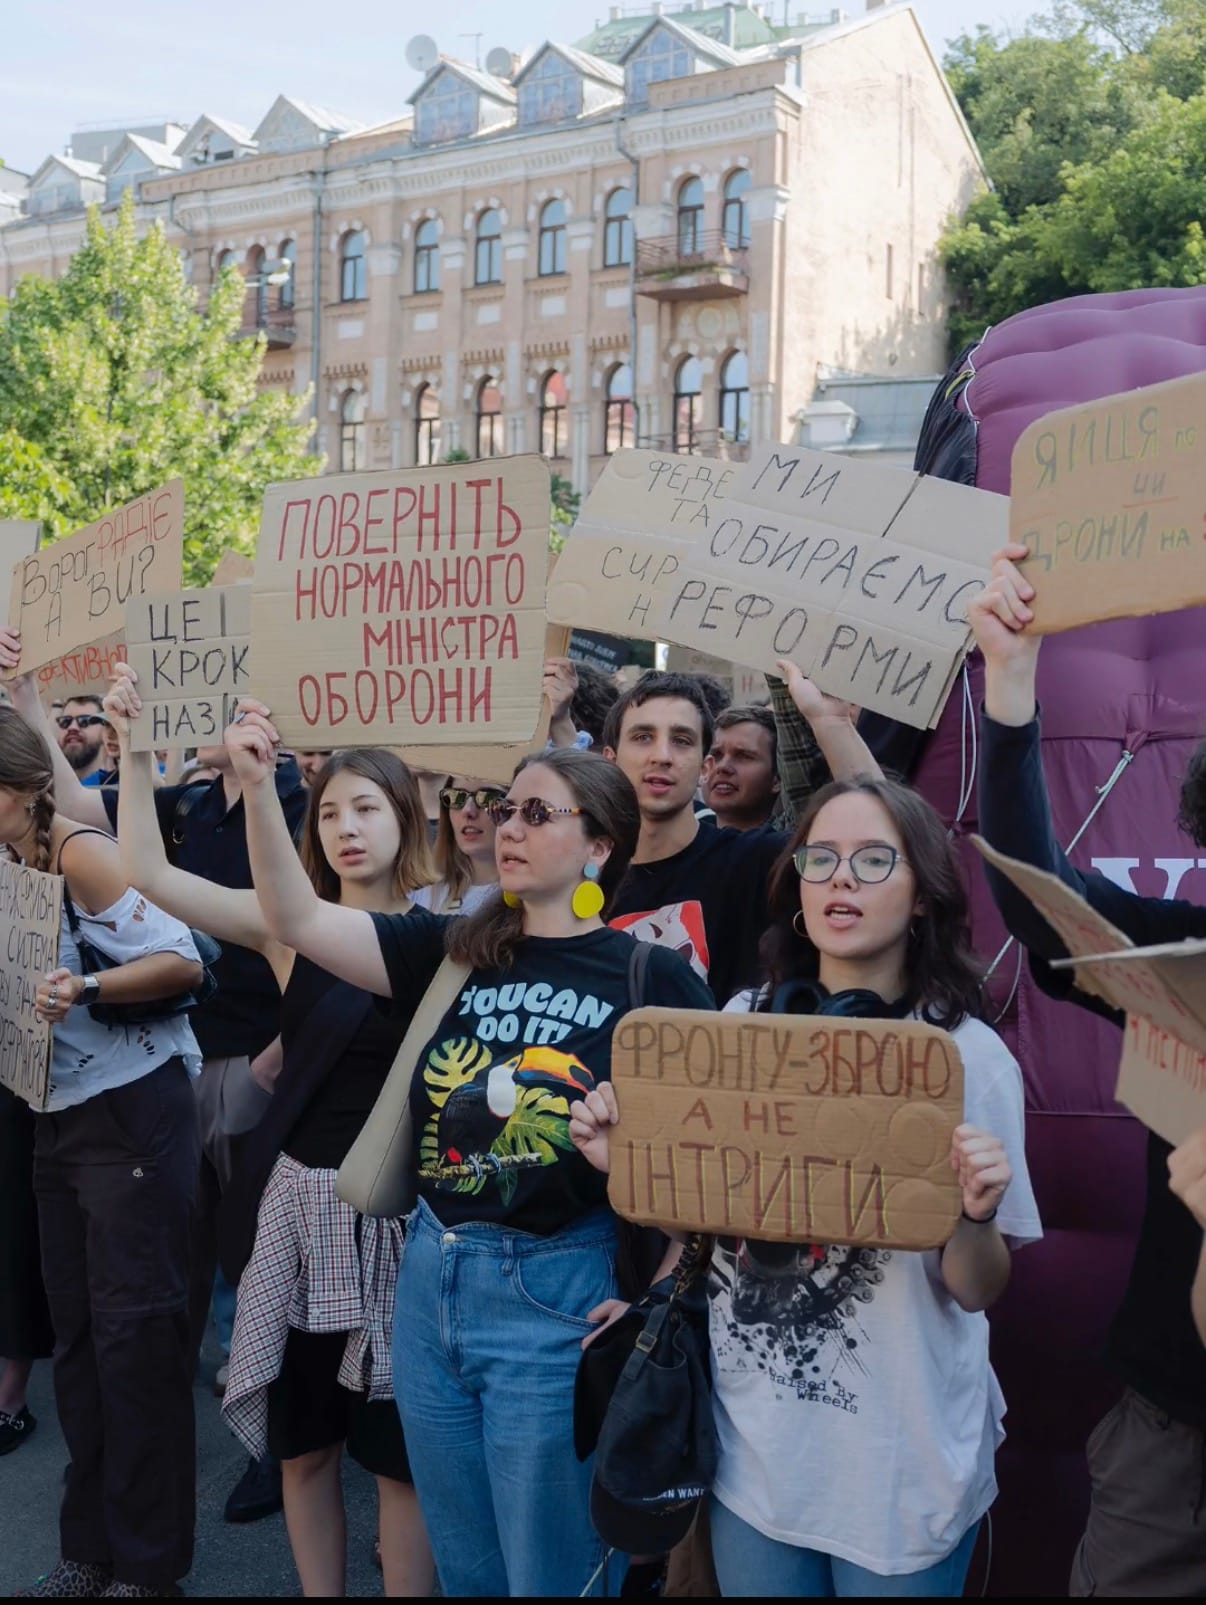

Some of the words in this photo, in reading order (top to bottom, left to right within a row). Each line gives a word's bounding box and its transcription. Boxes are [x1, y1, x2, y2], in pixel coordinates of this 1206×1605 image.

[752, 452, 842, 505] МИ
[278, 477, 522, 561] ПОВЕРНІТЬ
[671, 497, 711, 528] ТА
[601, 546, 680, 585] СИР
[1020, 511, 1149, 572] ДРОНИ
[1159, 528, 1191, 552] НА
[295, 552, 525, 621] НОРМАЛЬНОГО
[628, 593, 653, 627] Н
[363, 612, 519, 667] МІНІСТРА
[669, 579, 934, 707] РЕФОРМИ
[152, 644, 250, 690] КРОК
[297, 666, 493, 727] ОБОРОНИ
[8, 925, 55, 974] СИСТЕМА
[476, 1013, 519, 1042] DO
[523, 1015, 573, 1044] IT!
[618, 1021, 951, 1099] ФРОНТУ-ЗБРОЮ
[682, 1097, 714, 1130] А
[744, 1101, 798, 1136] НЕ
[627, 1139, 889, 1239] ІНТРИГИ
[797, 1388, 859, 1415] Wheels
